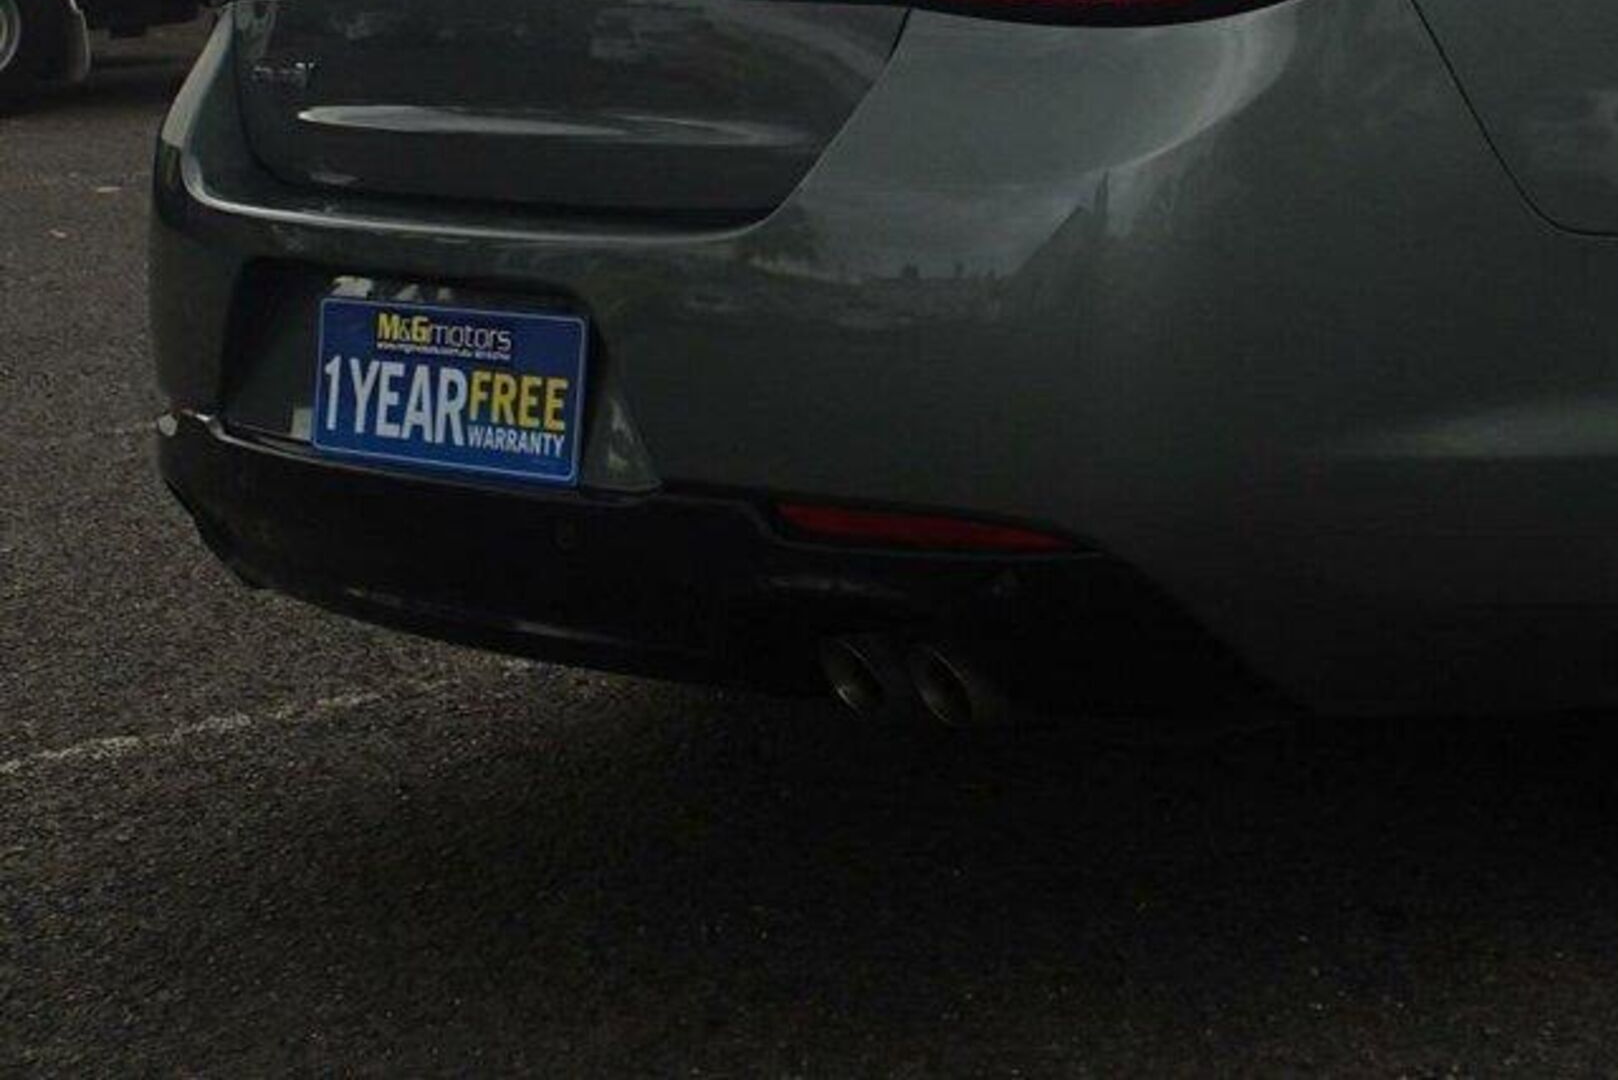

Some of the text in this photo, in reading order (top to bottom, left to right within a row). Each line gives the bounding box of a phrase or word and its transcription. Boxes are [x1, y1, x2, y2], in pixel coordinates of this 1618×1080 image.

[349, 357, 466, 446] YEAR
[468, 369, 570, 432] FREE
[467, 424, 566, 458] WARRANTY
